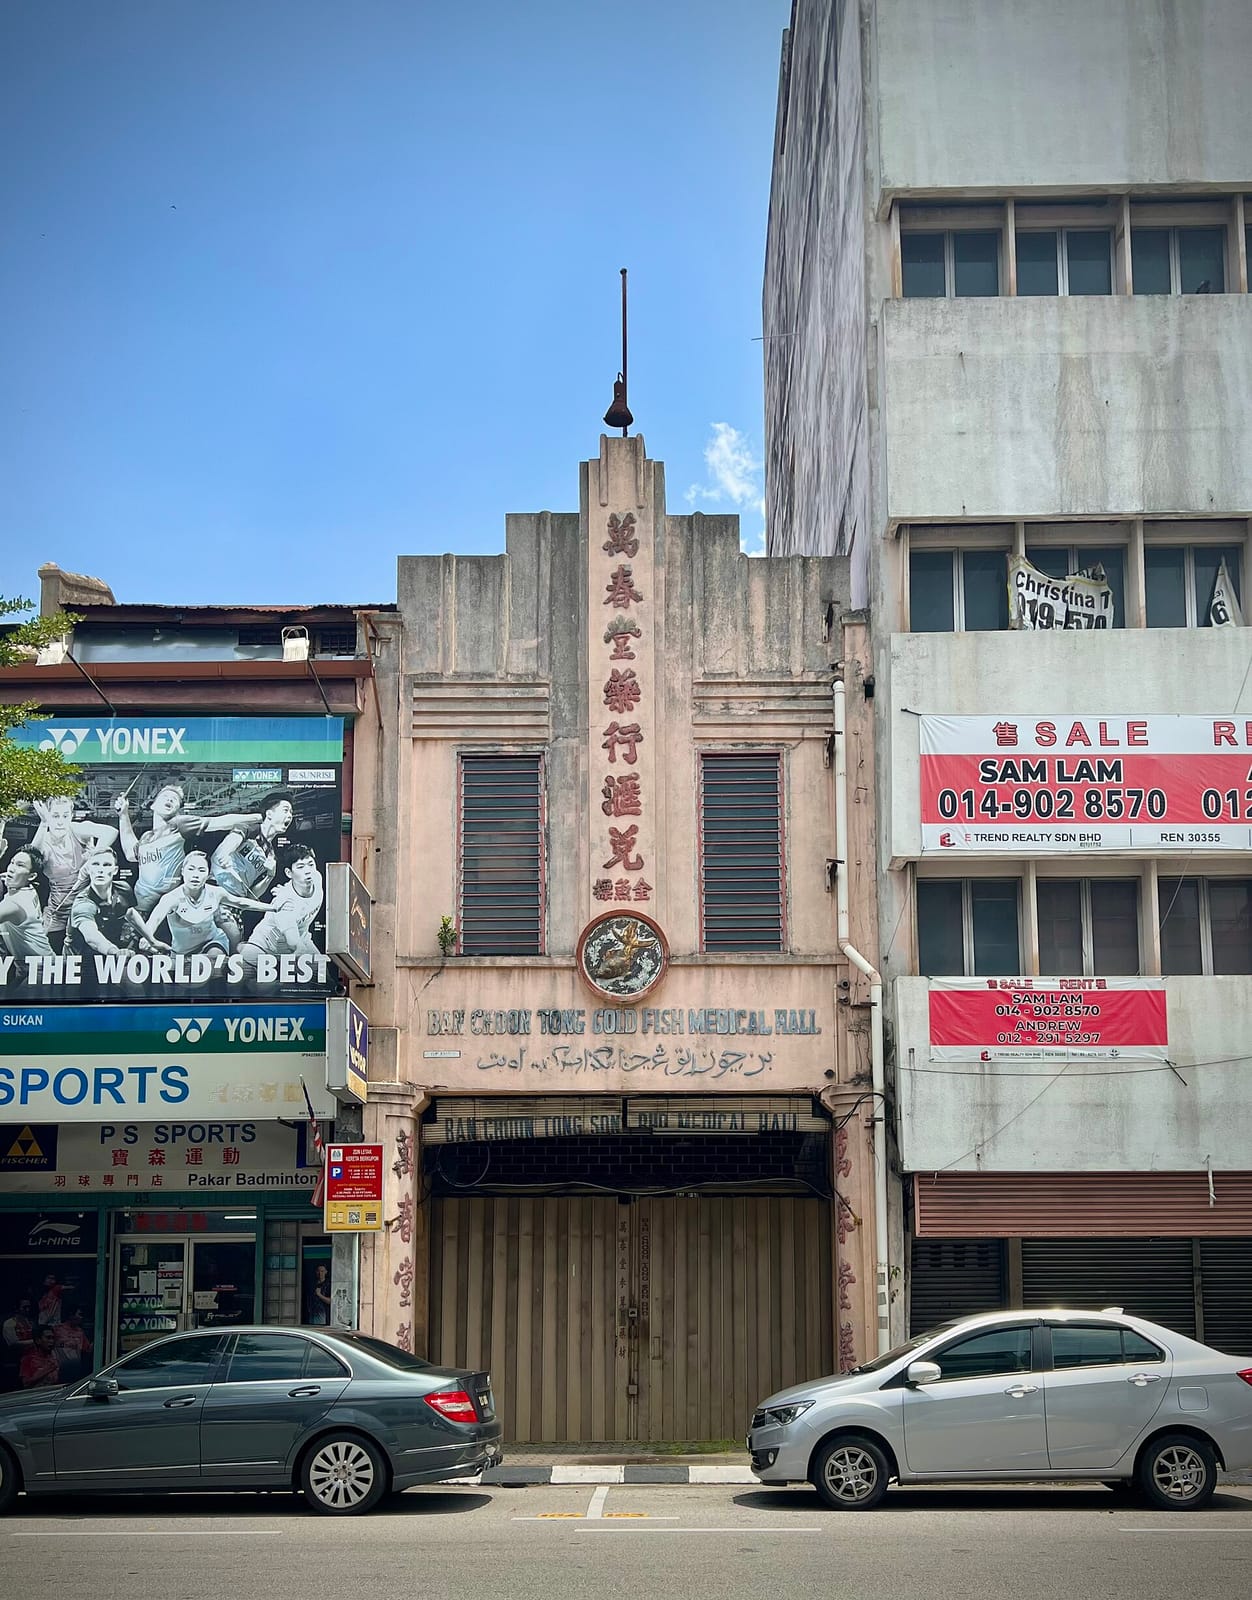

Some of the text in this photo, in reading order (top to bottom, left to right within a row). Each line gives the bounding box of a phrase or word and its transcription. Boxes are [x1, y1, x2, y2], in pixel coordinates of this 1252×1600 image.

[1016, 571, 1095, 609] Christina
[992, 722, 1019, 746] 售
[1034, 721, 1149, 746] SALE
[96, 727, 187, 754] YONEX
[252, 771, 279, 780] YONEX
[299, 771, 334, 779] SUNRISE
[979, 760, 1123, 783] SAM LAM
[938, 788, 1167, 819] 014-902 8570
[974, 833, 1009, 842] TREND
[1012, 833, 1051, 842] REALTY
[1055, 833, 1076, 842] SDN
[1079, 833, 1102, 842] BHD
[1160, 833, 1220, 842] REN 30355
[25, 955, 81, 984] THE
[94, 954, 243, 985] WORLD'S
[257, 954, 331, 983] BEST
[1000, 979, 1094, 989] SALE RENT
[1013, 994, 1082, 1003] SAM LAM
[996, 1006, 1020, 1015] 014
[1034, 1006, 1060, 1015] 902
[1064, 1006, 1100, 1016] 8570
[3, 1015, 43, 1026] SUKAN
[427, 1008, 821, 1035] BAN CHOON TONG GOLD FISH MEDICAL HALL
[1015, 1021, 1081, 1031] ANDREW
[224, 1017, 306, 1043] YONEX
[997, 1033, 1021, 1042] 012
[1037, 1033, 1059, 1042] 291
[1065, 1033, 1100, 1043] 5297
[154, 1124, 256, 1144] SPORTS
[445, 1117, 476, 1142] BAN
[545, 1116, 584, 1137] TONG
[112, 1147, 240, 1167] 寶森運動
[332, 1167, 341, 1177] P
[54, 1174, 163, 1187] 羽球專門店
[188, 1173, 317, 1186] Pakar Badminton
[28, 1237, 80, 1246] LI-NING
